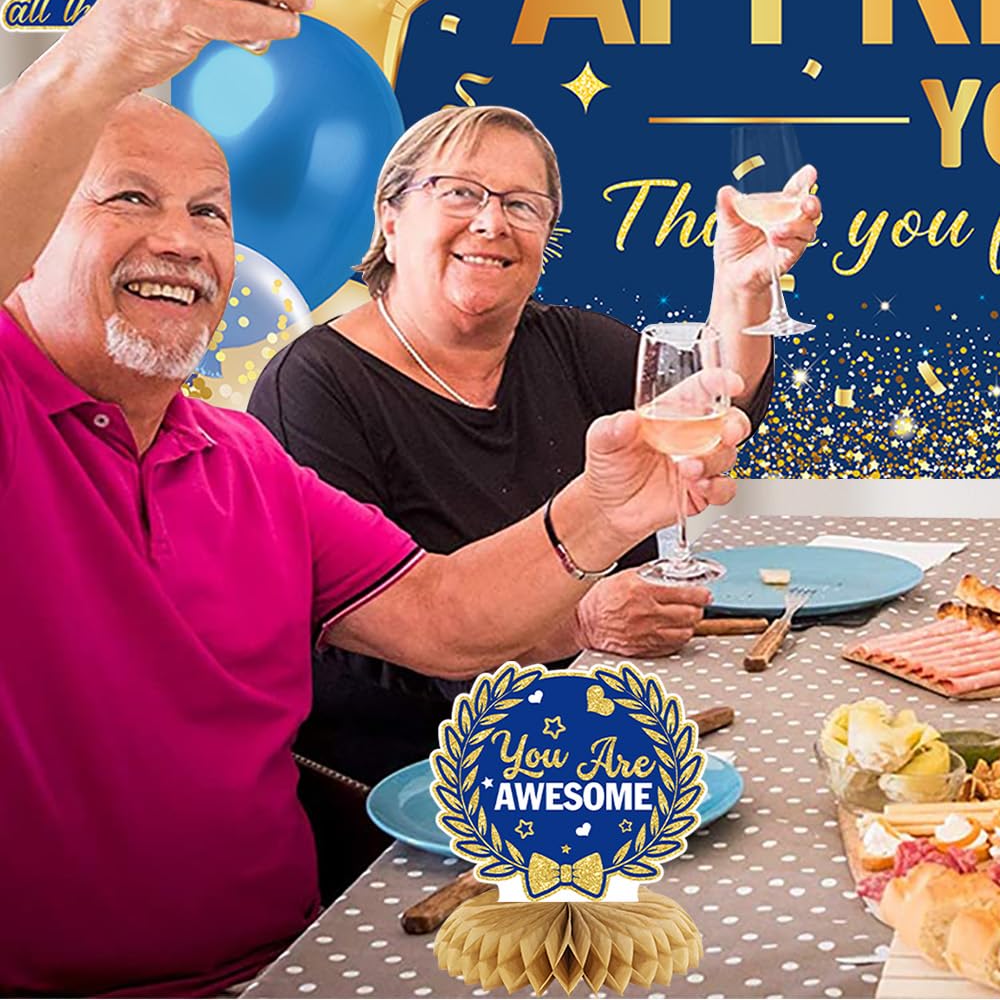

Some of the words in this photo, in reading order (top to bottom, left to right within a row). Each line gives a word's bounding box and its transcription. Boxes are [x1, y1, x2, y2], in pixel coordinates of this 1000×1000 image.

[832, 209, 976, 276] you
[491, 729, 569, 780] You
[576, 736, 656, 781] Are
[494, 782, 653, 812] AWESOME
